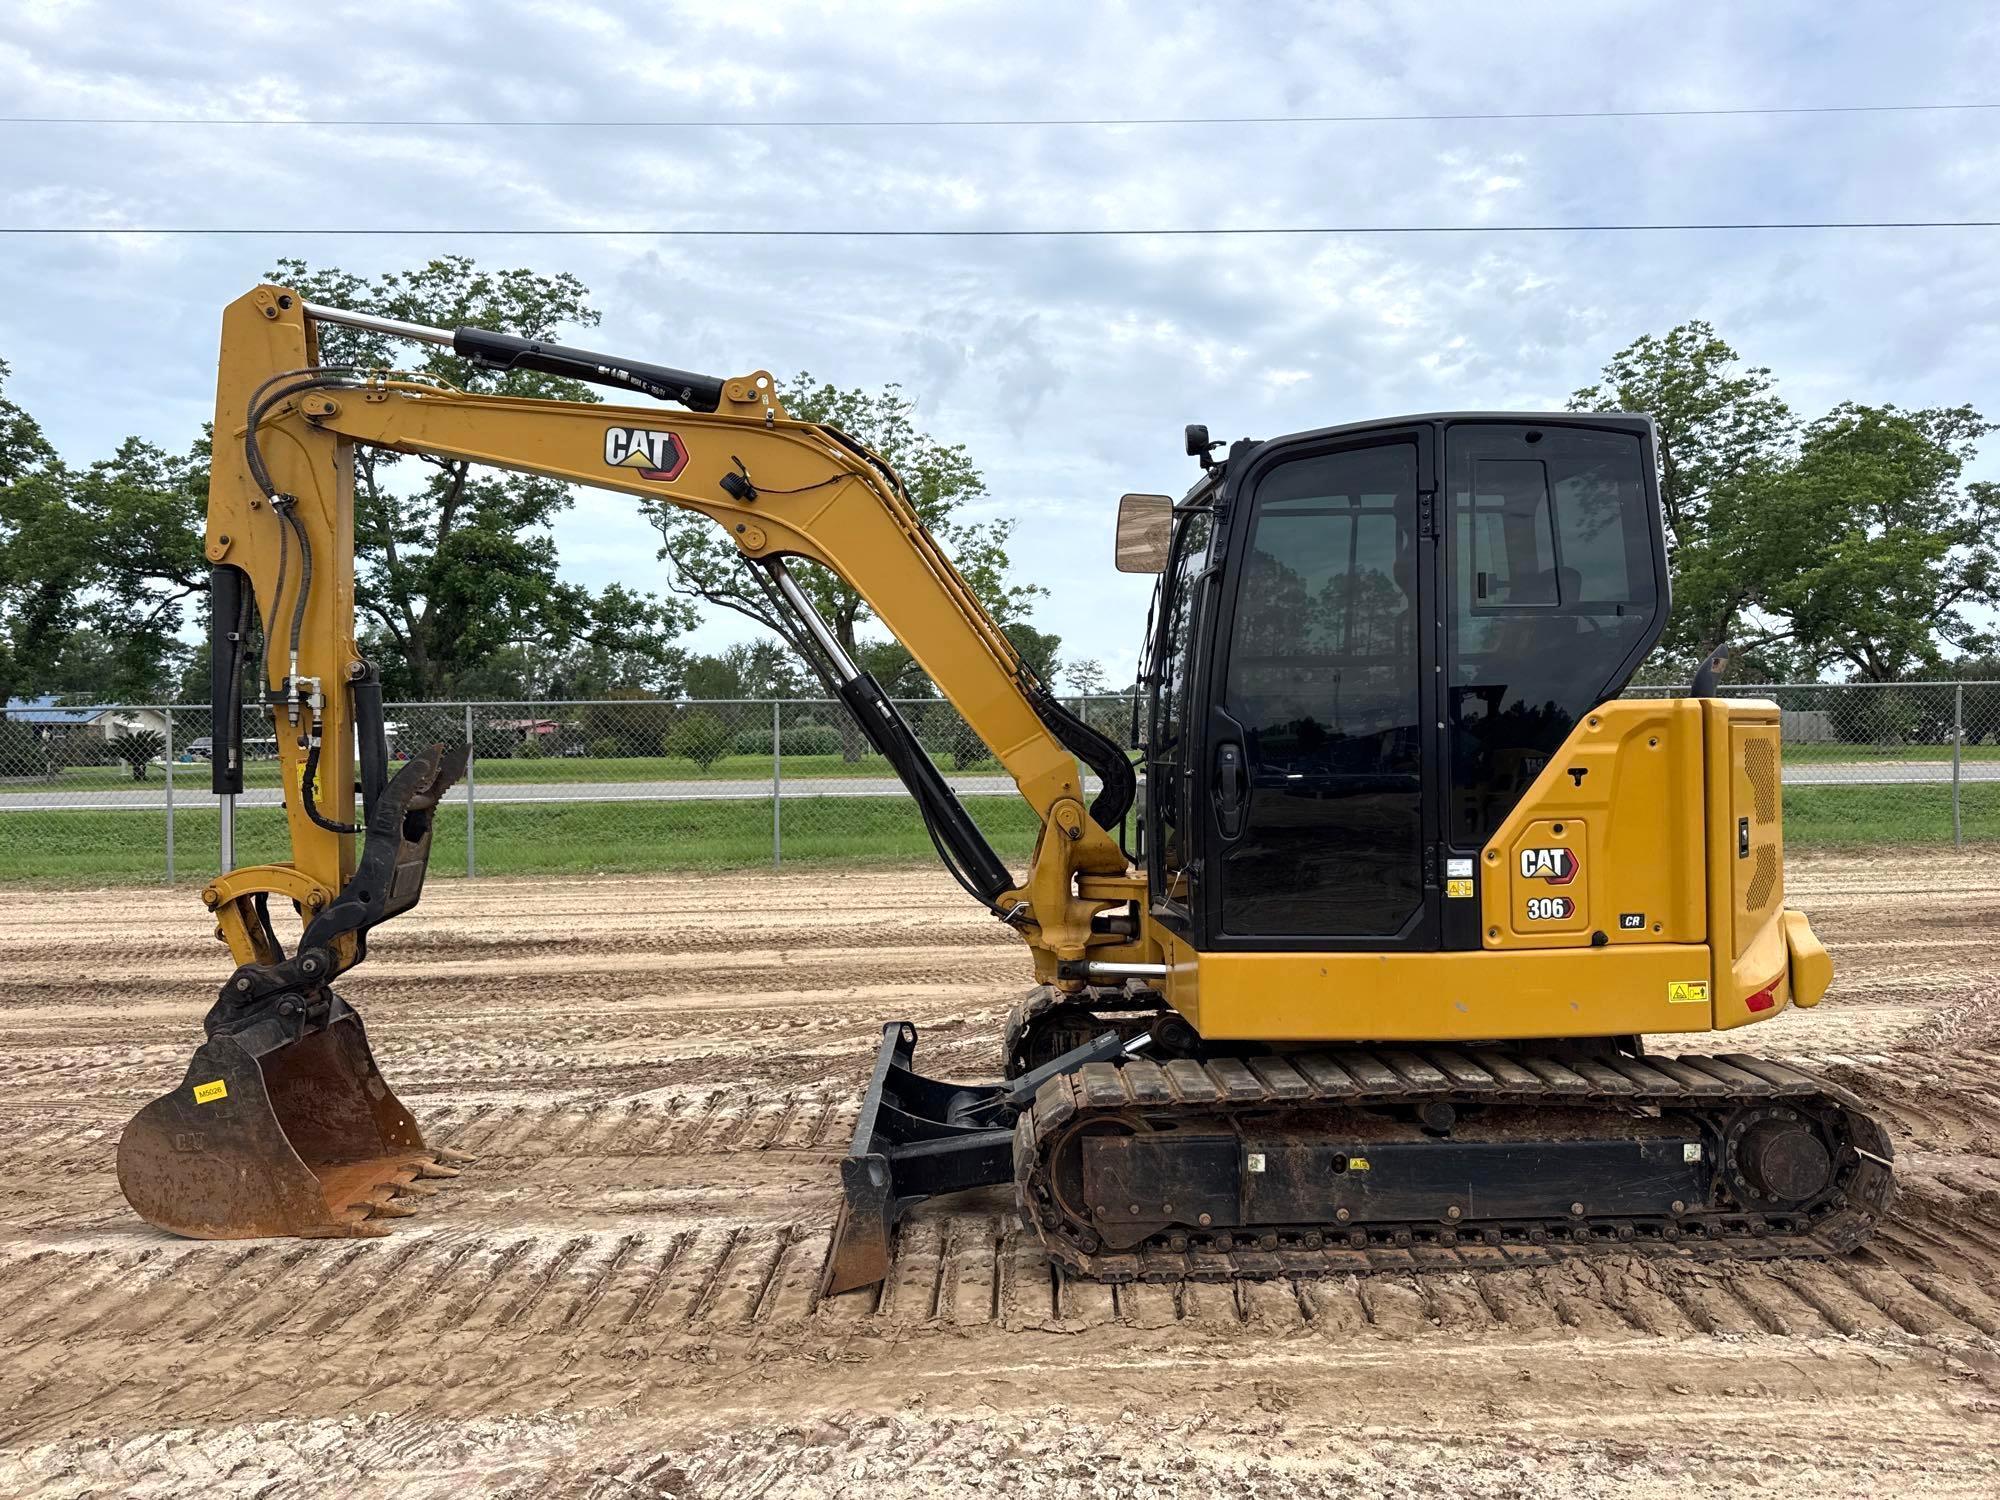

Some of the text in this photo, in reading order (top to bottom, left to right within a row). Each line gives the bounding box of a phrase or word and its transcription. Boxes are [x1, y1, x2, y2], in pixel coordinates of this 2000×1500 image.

[605, 427, 669, 470] CAT
[1521, 849, 1565, 877] CAT
[1528, 898, 1565, 919] 306
[1625, 916, 1640, 927] CR
